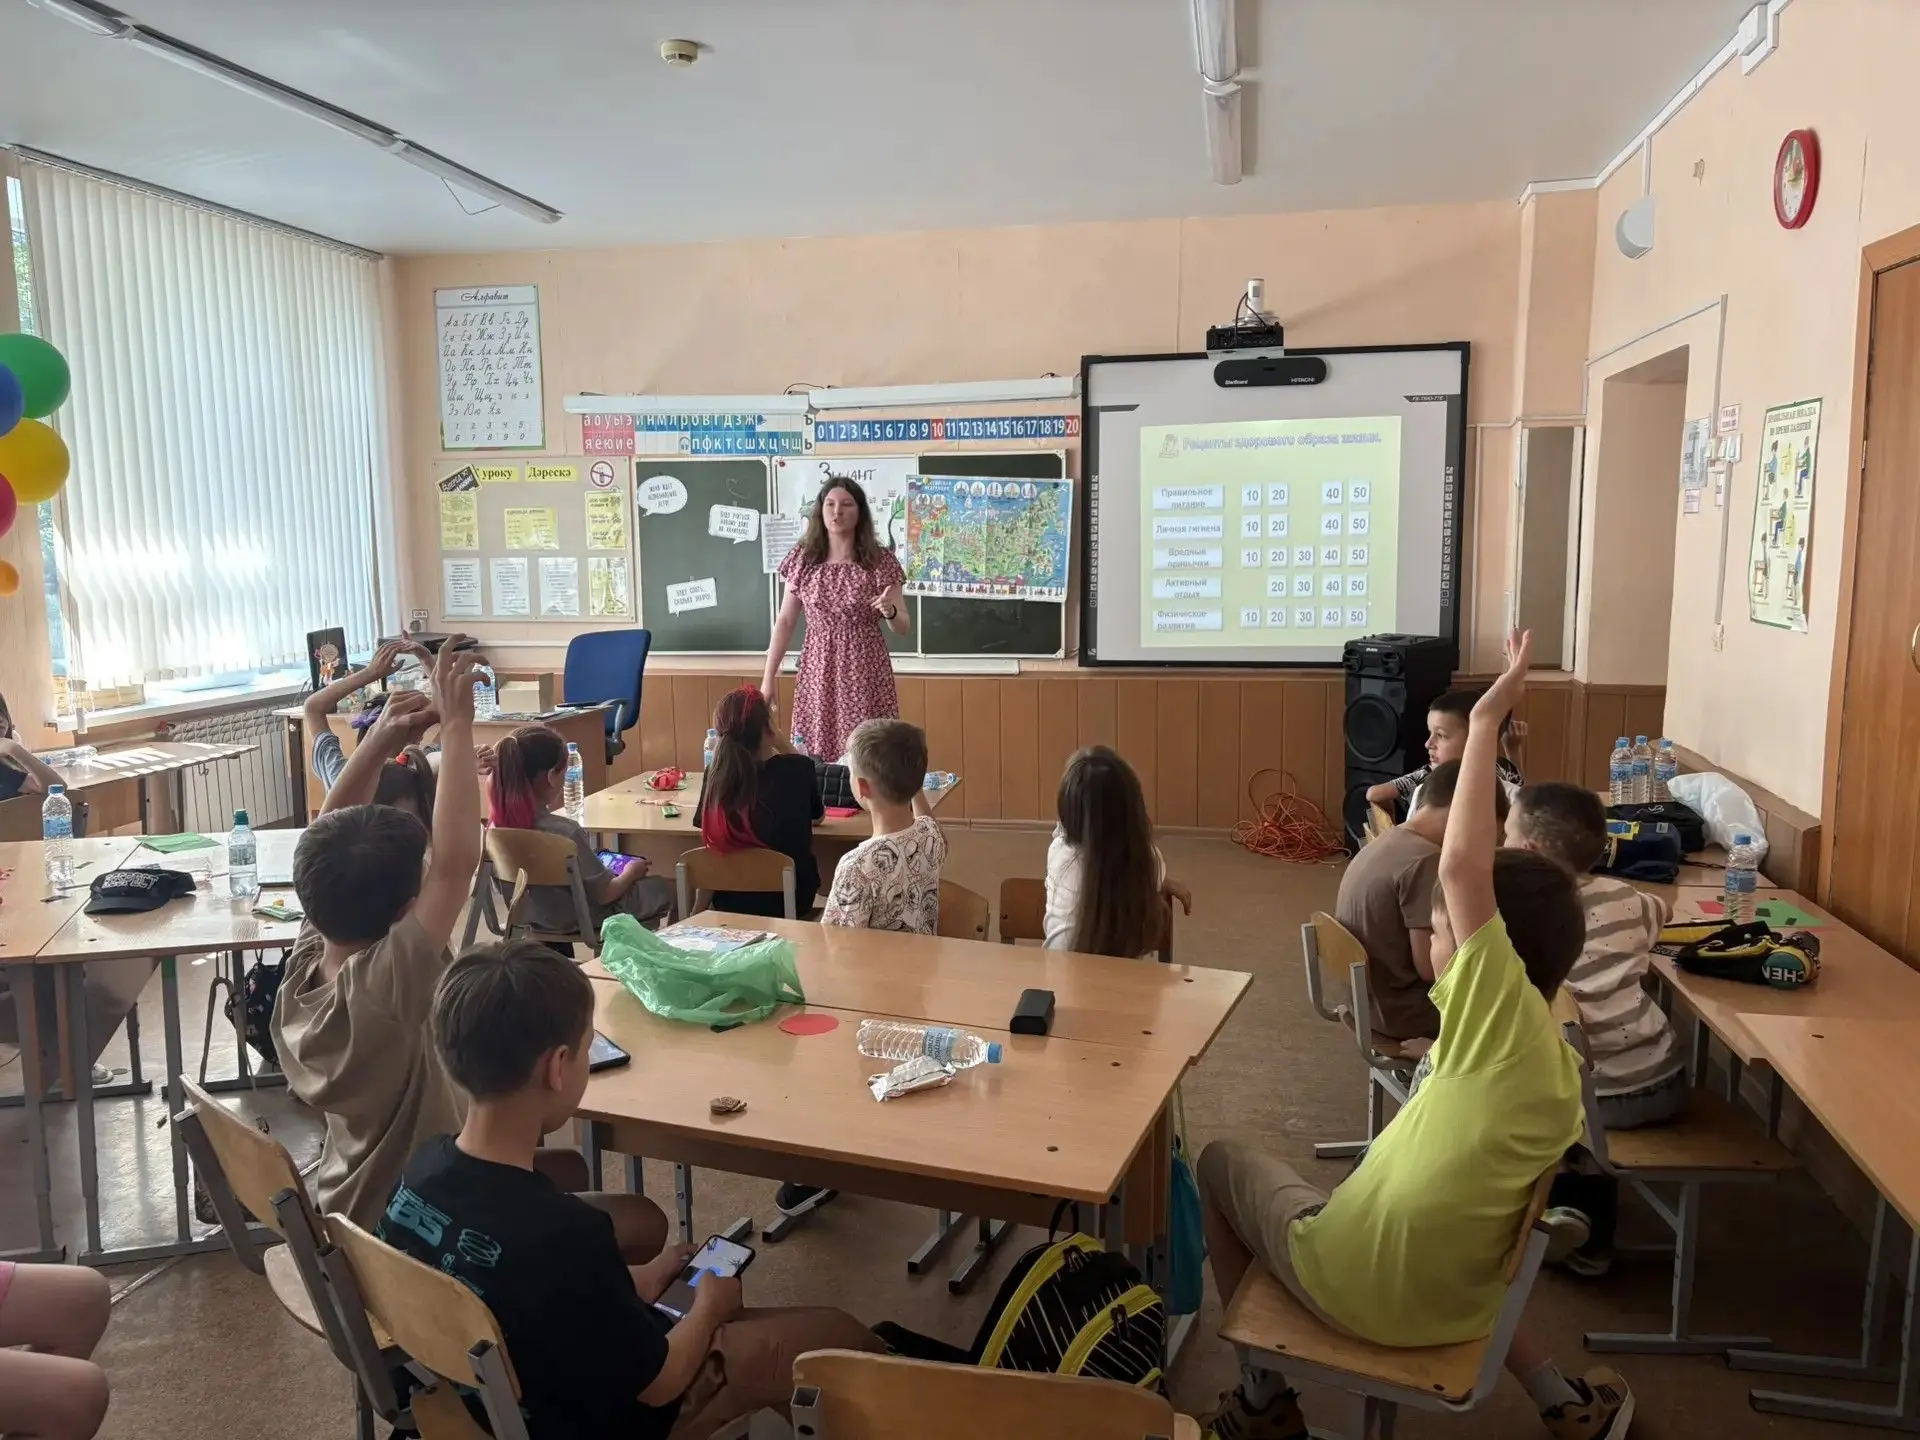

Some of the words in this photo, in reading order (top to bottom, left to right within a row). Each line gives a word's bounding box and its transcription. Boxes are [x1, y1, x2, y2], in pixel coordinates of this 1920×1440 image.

[818, 422, 824, 439] 0
[830, 422, 835, 438] 1
[840, 422, 848, 438] 2
[851, 422, 858, 438] 3
[862, 422, 870, 438] 4
[874, 421, 881, 438] 5
[886, 421, 893, 438] 6
[898, 421, 904, 438] 7
[910, 420, 917, 437] 8
[922, 420, 929, 437] 9
[933, 420, 944, 437] 10
[946, 420, 957, 436] 11
[959, 419, 970, 436] 12
[972, 419, 983, 436] 13
[985, 418, 997, 436] 14
[1000, 418, 1010, 436] 15
[1012, 418, 1024, 436] 16
[1026, 418, 1036, 435] 17
[1039, 418, 1050, 435] 18
[1052, 418, 1064, 434] 19
[1066, 417, 1078, 434] 20
[482, 470, 512, 480] уроку
[528, 468, 571, 479] Дәрескә
[1162, 488, 1212, 498] Правильное
[1247, 490, 1258, 501] 10
[1272, 490, 1285, 500] 20
[1326, 488, 1339, 498] 40
[1354, 487, 1366, 498] 50
[1156, 526, 1186, 534] Личная
[1246, 522, 1258, 532] 10
[1272, 520, 1284, 532] 20
[1326, 520, 1338, 530] 40
[1353, 518, 1366, 529] 50
[1246, 552, 1258, 562] 10
[1272, 552, 1284, 562] 20
[1298, 551, 1311, 561] 30
[1325, 550, 1338, 560] 40
[1352, 549, 1365, 560] 50
[1166, 578, 1207, 586] Активный
[1271, 582, 1284, 592] 20
[1298, 582, 1310, 592] 30
[1326, 581, 1340, 591] 40
[1352, 580, 1364, 591] 50
[1246, 612, 1258, 622] 10
[1271, 612, 1284, 622] 20
[1300, 611, 1312, 622] 30
[1326, 611, 1338, 622] 40
[1351, 611, 1364, 622] 50
